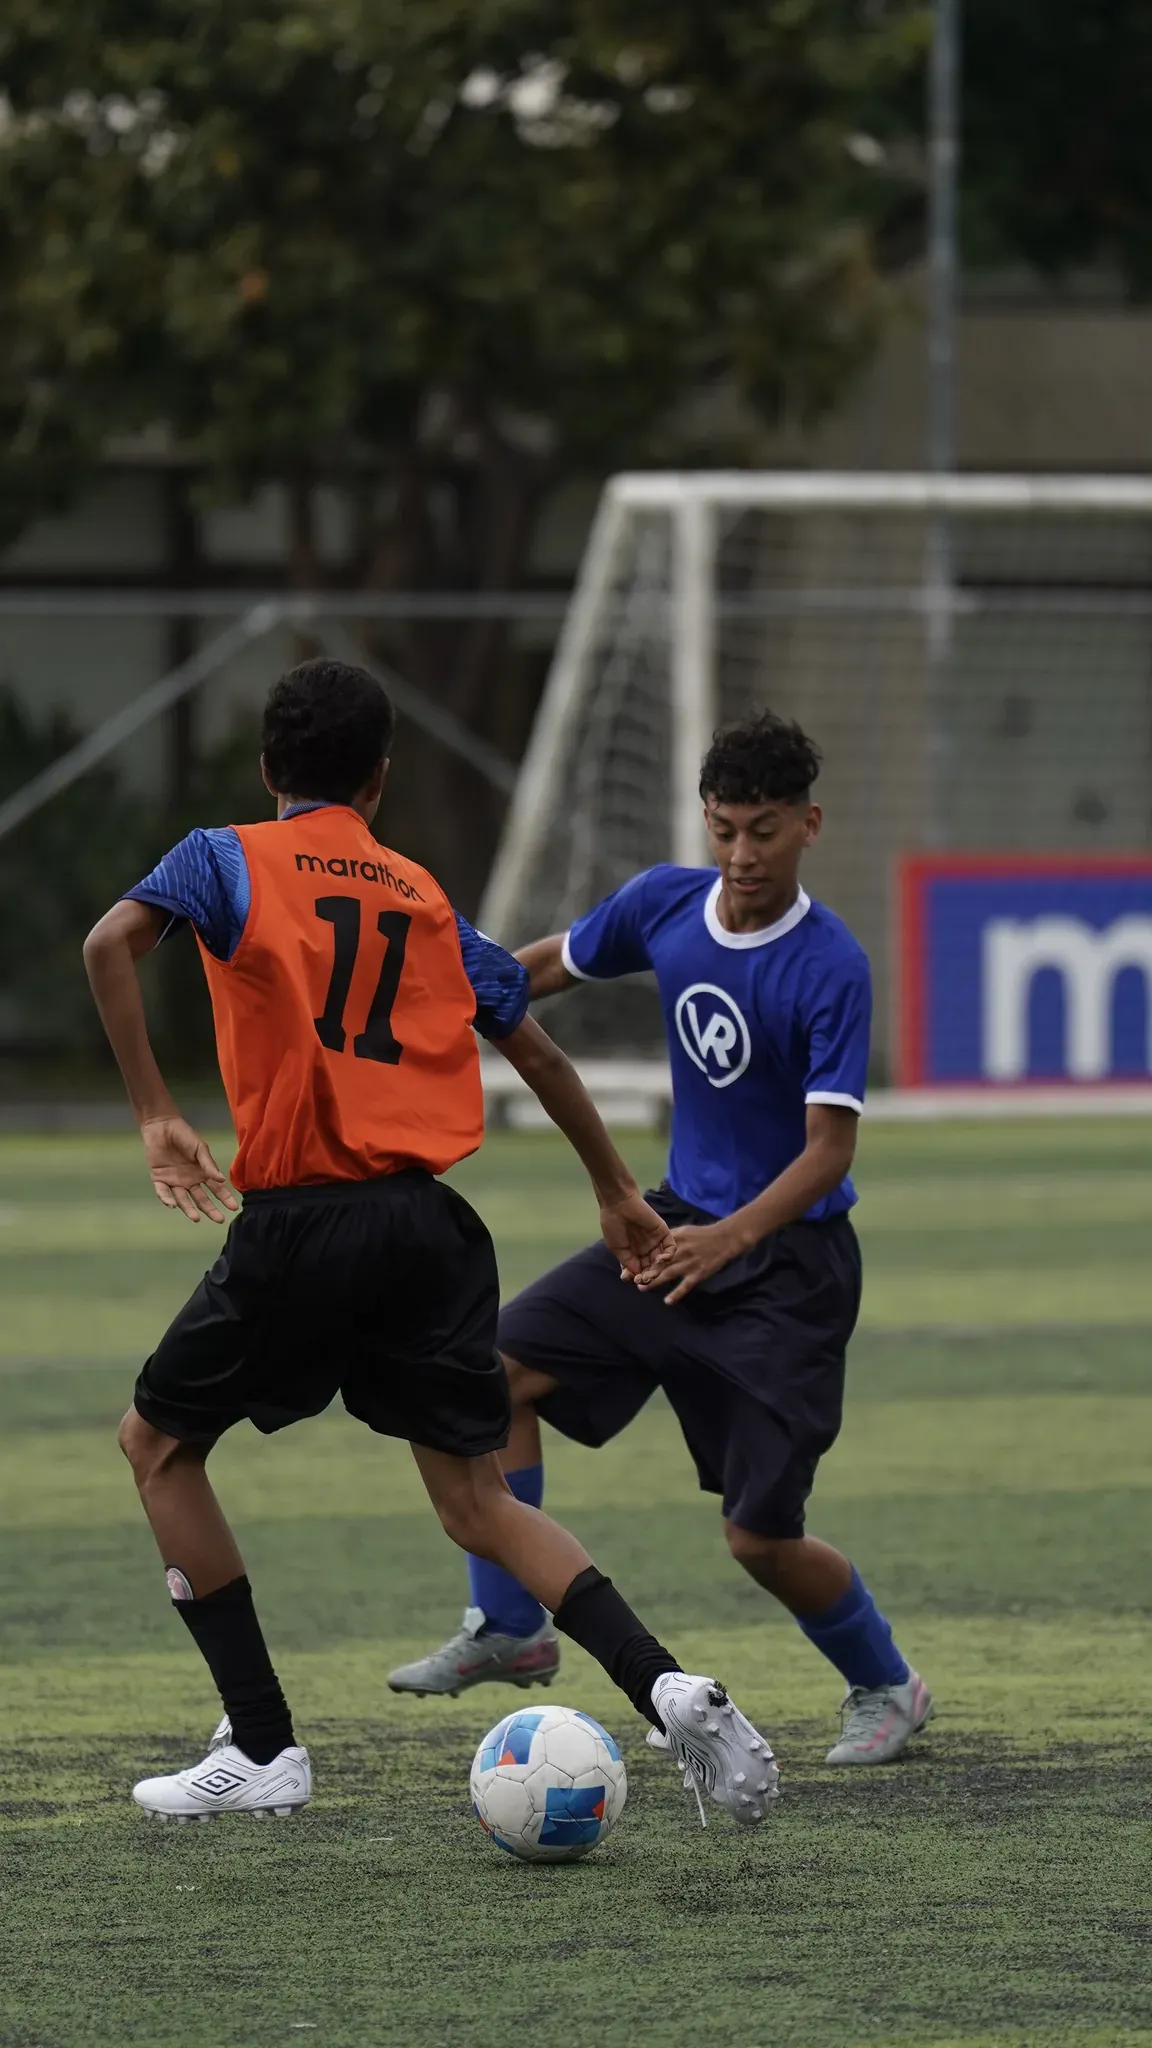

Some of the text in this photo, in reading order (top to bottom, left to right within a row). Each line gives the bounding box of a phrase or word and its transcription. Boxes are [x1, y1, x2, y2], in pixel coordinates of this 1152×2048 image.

[294, 853, 426, 903] marathon
[313, 896, 412, 1065] 11
[685, 1000, 737, 1069] VR
